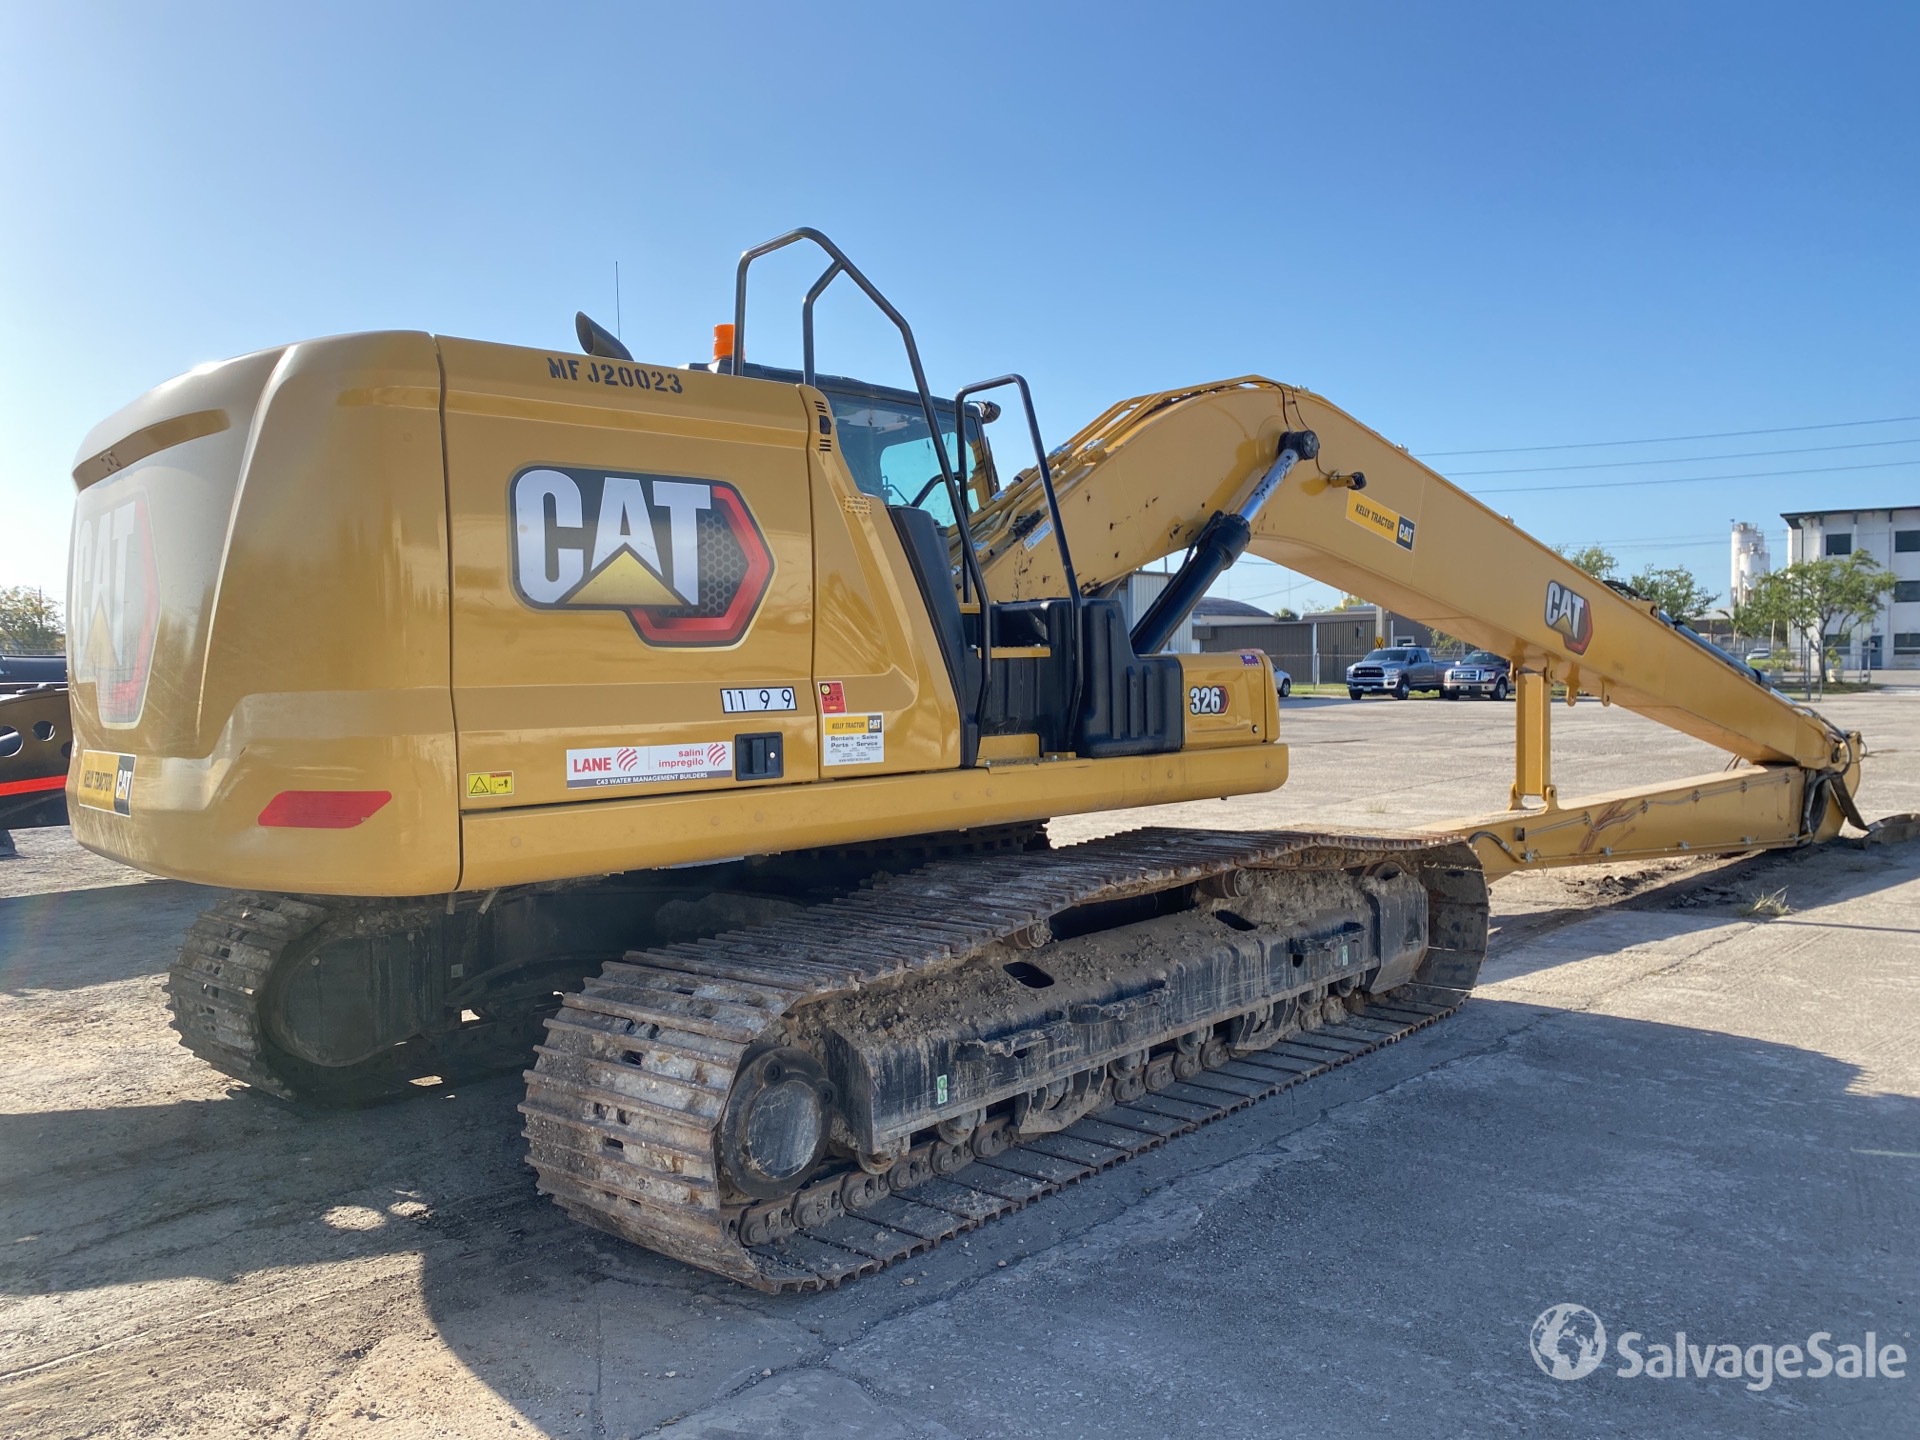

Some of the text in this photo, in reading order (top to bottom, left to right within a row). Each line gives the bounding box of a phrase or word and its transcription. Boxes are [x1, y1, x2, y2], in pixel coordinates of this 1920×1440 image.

[1355, 502, 1395, 531] KELLY TRACTOR
[515, 469, 711, 606] CAT
[1399, 523, 1413, 543] CAT
[76, 501, 136, 673] CAT
[1546, 581, 1585, 639] CAT
[726, 689, 792, 711] 1199
[1190, 687, 1221, 714] 326
[845, 721, 865, 729] TRACTOR
[869, 719, 881, 730] CAT
[658, 757, 704, 769] impregilo
[678, 748, 704, 757] salini
[573, 757, 612, 773] LANE
[116, 769, 132, 800] CAT
[609, 777, 632, 785] WATER
[632, 774, 678, 783] MANAGEMENT
[679, 772, 708, 780] BUILDERS
